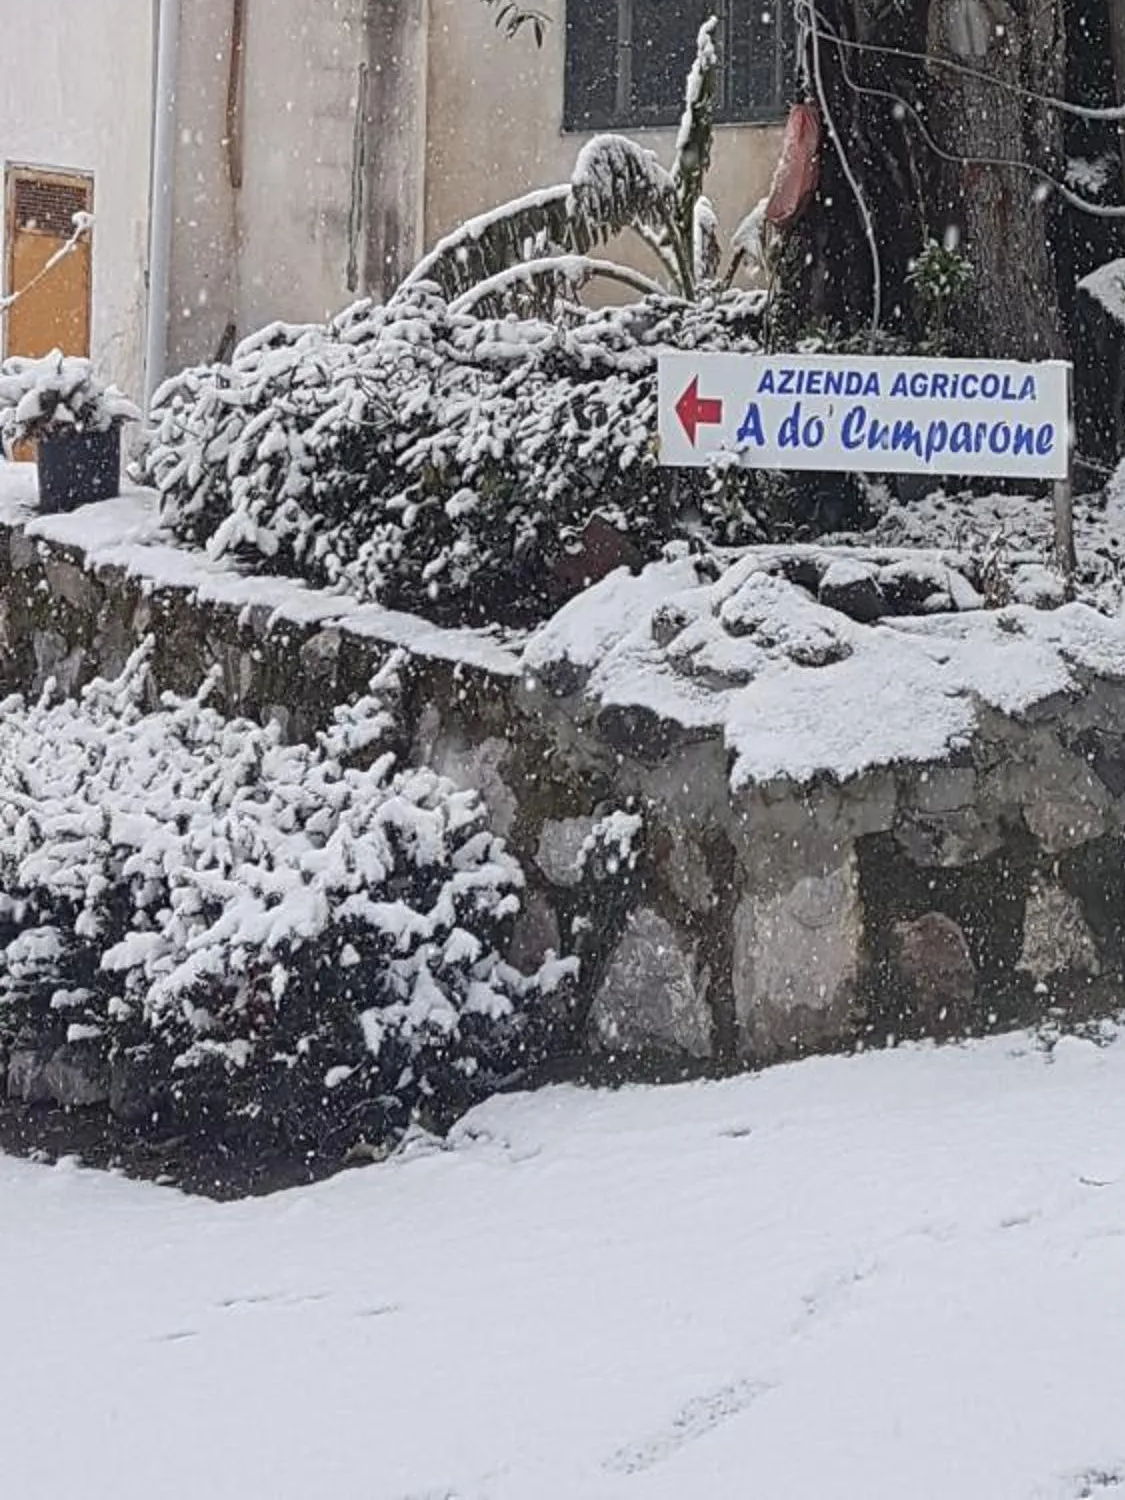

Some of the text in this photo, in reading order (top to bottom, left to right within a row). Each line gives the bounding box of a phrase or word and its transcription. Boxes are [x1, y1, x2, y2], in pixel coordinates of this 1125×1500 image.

[758, 368, 881, 397] AZIENDA
[736, 402, 766, 447] A
[840, 405, 1055, 464] Cumparone
